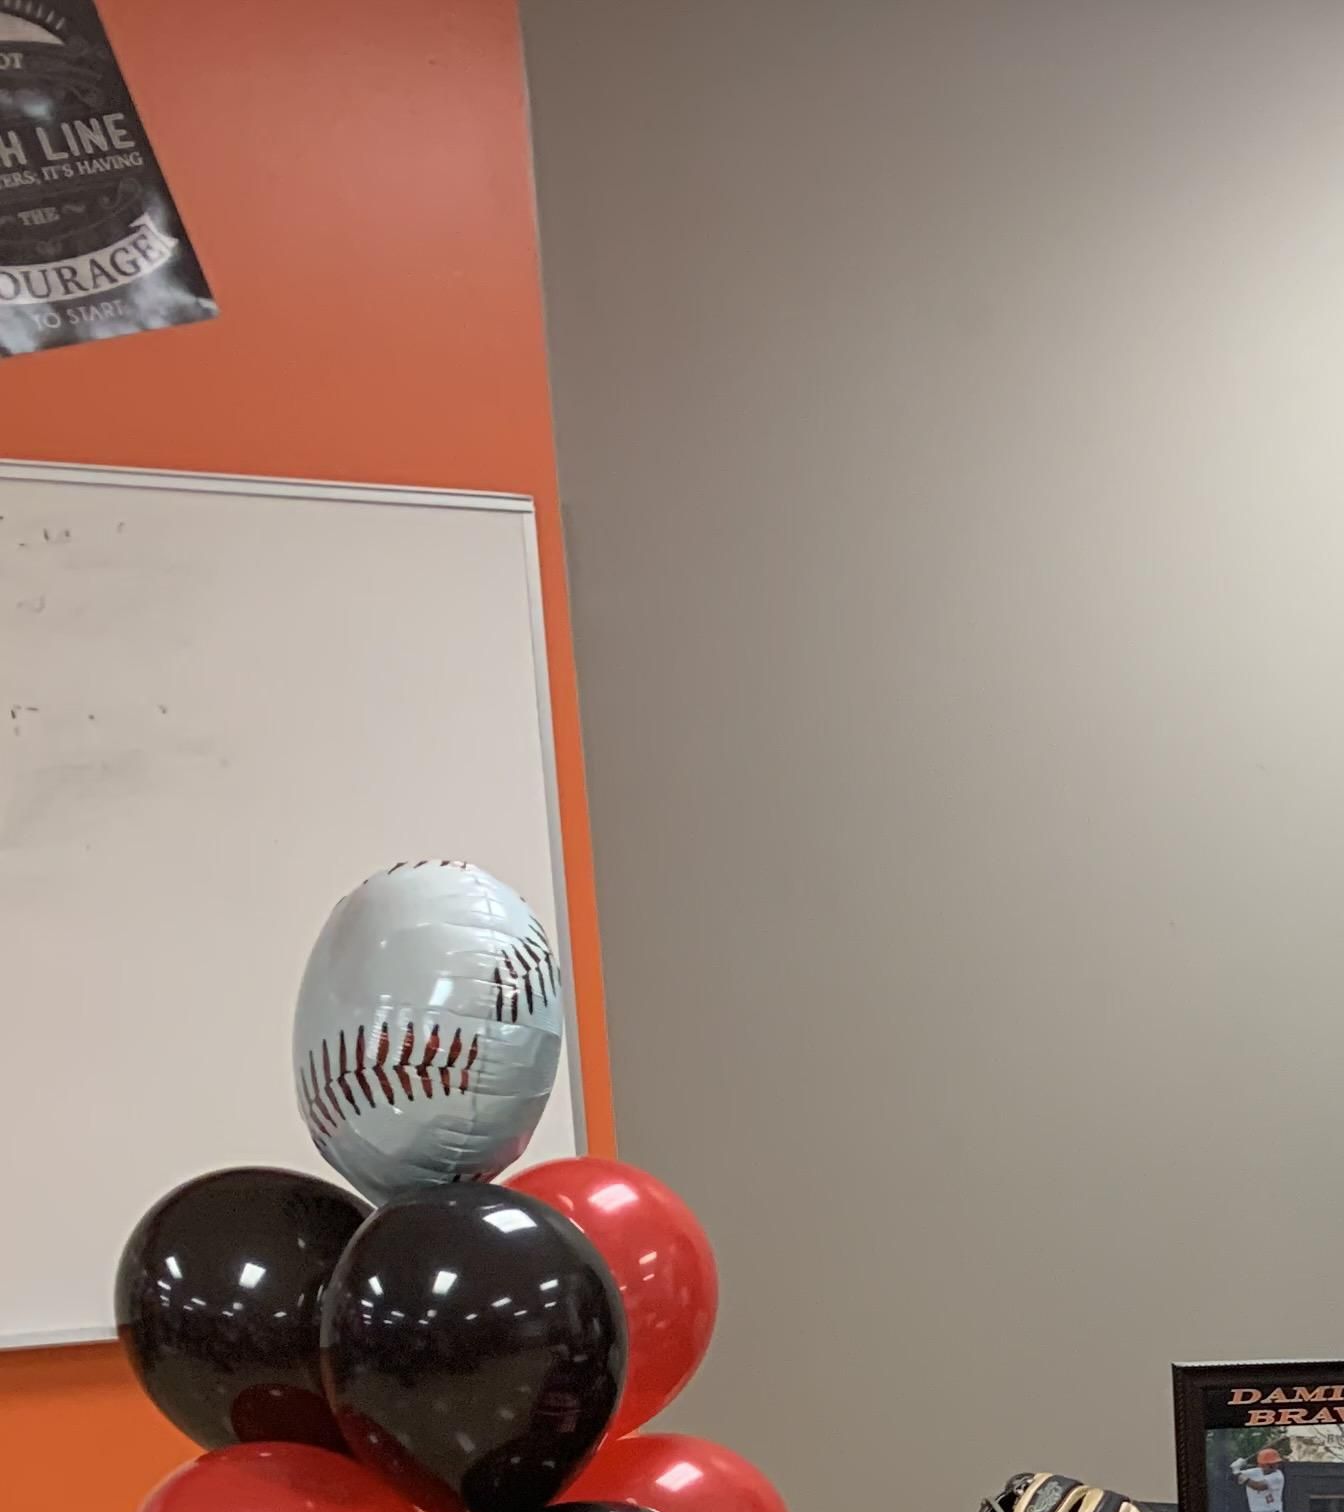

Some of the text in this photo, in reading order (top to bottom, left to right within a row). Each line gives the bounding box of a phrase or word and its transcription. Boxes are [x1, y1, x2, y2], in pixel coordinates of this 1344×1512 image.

[35, 113, 135, 161] LINE
[41, 164, 74, 181] IT'S
[75, 152, 143, 175] HAVING
[17, 206, 60, 226] THE
[31, 311, 62, 331] TO
